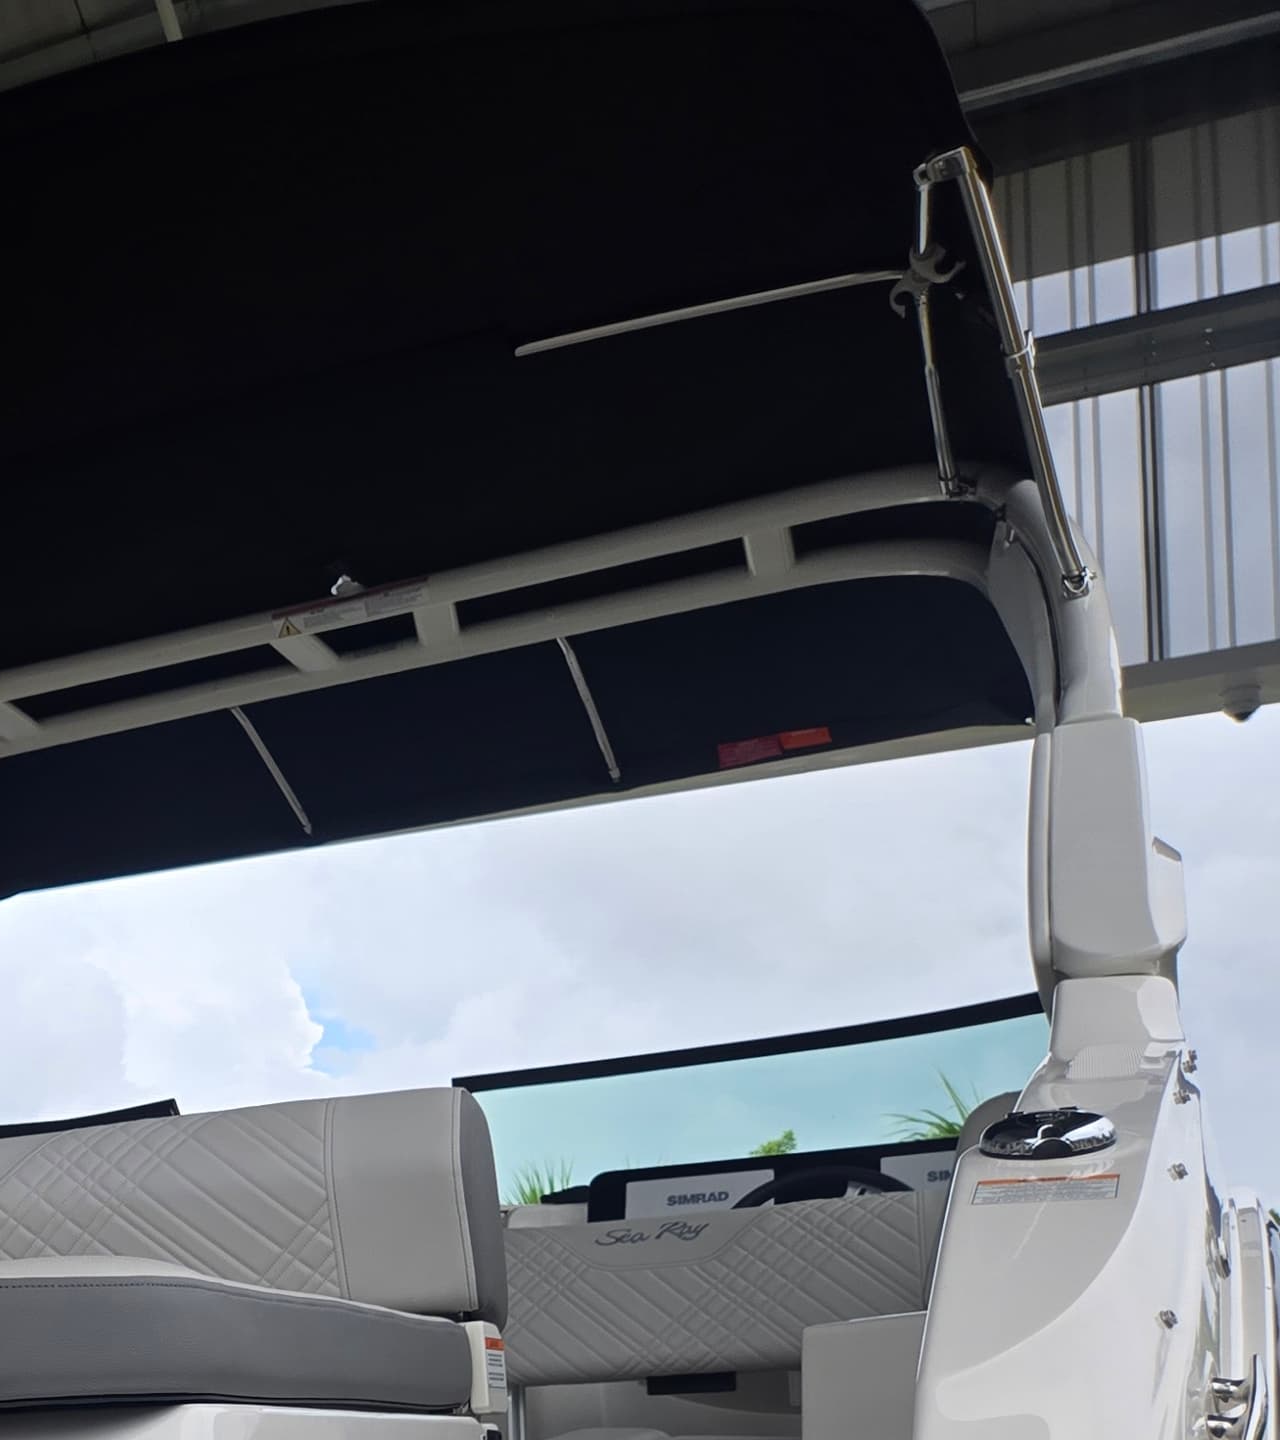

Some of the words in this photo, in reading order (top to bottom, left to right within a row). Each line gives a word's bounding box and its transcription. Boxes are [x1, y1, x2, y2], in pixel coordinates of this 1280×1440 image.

[666, 1190, 730, 1207] SIMRAD
[595, 1228, 649, 1247] Sea
[654, 1220, 709, 1241] Ray
